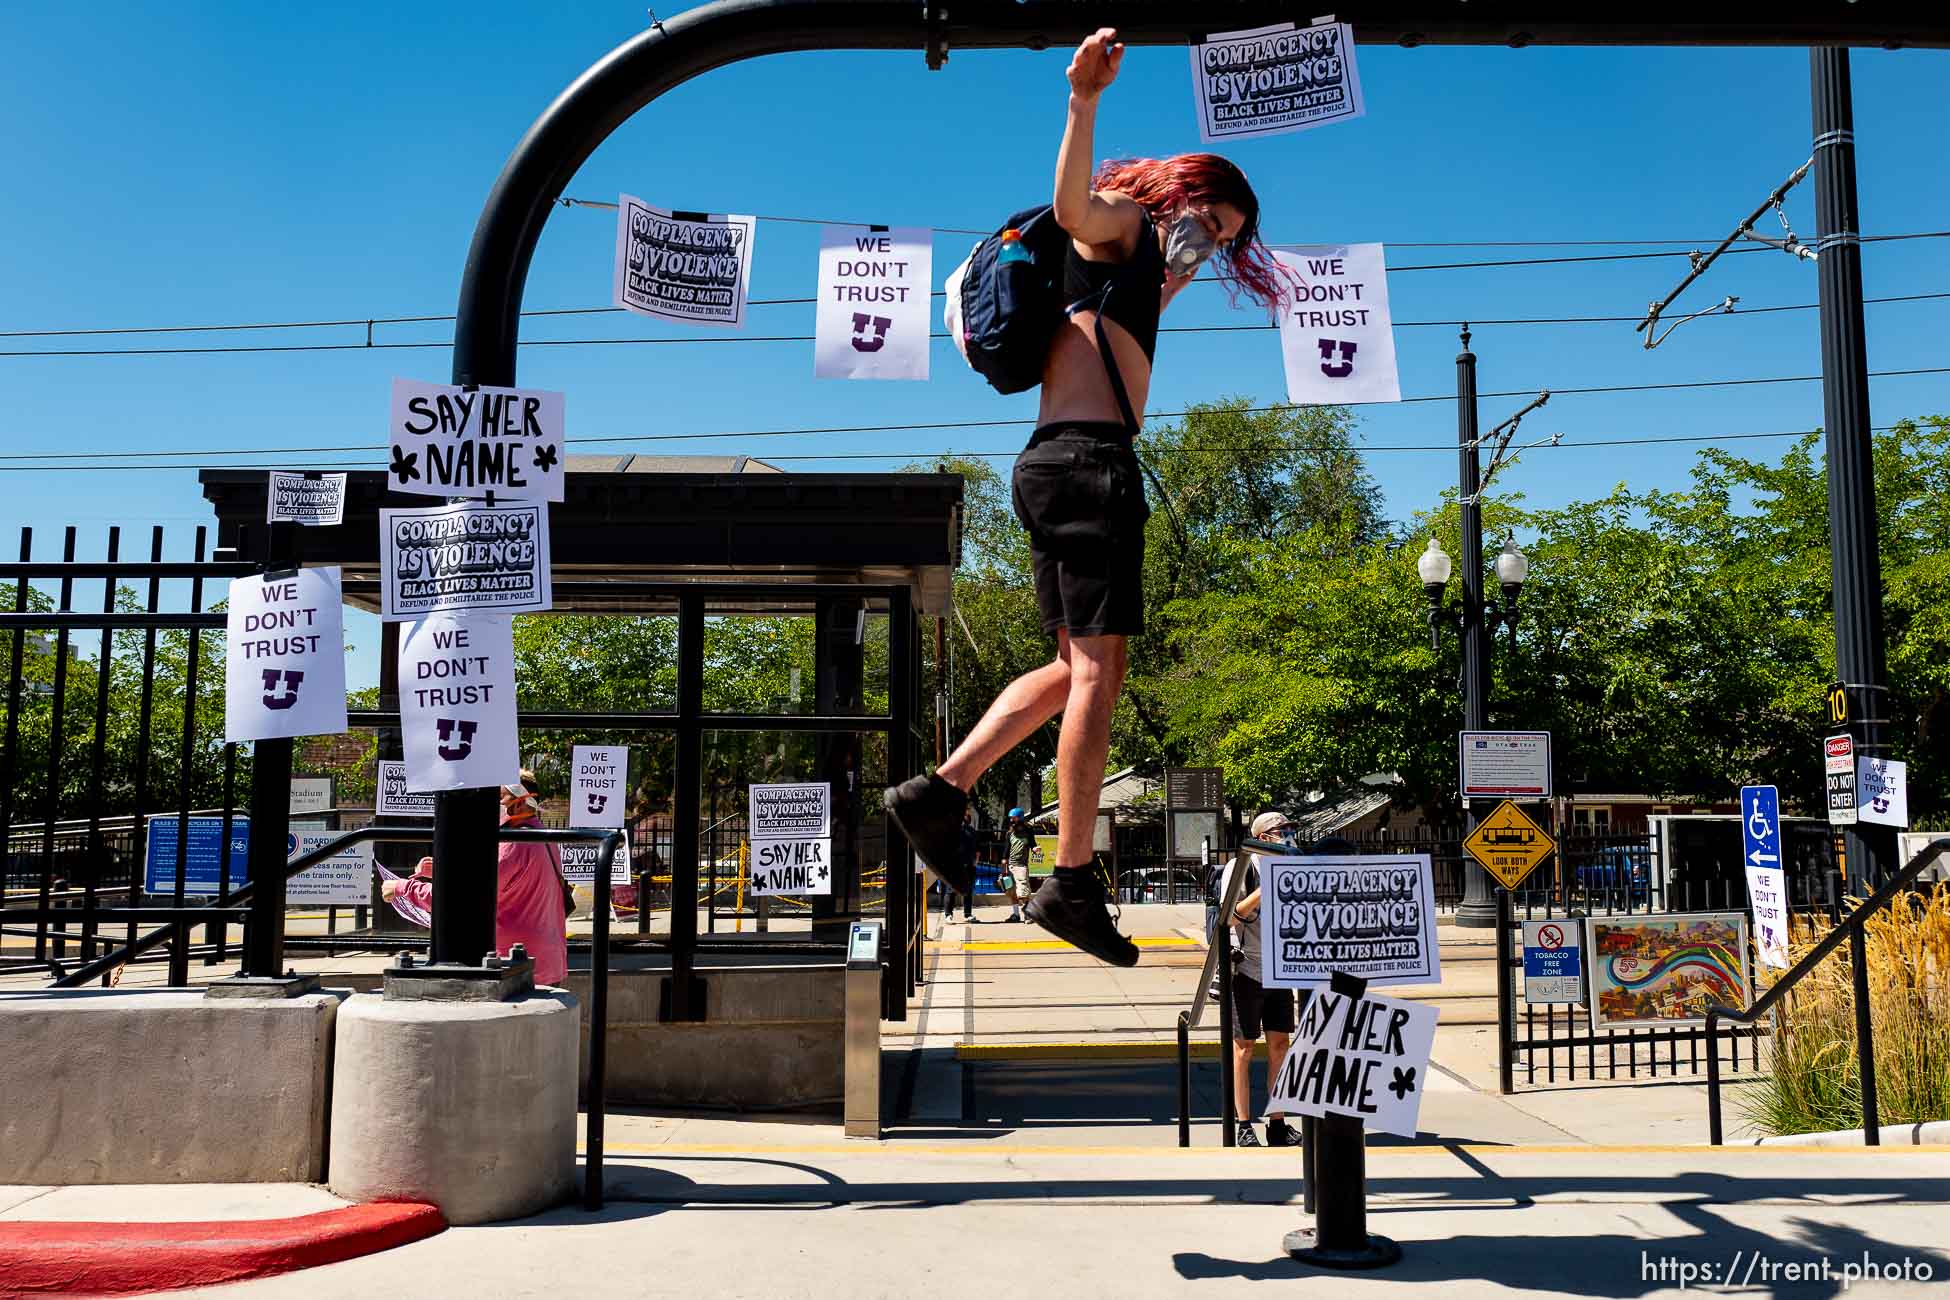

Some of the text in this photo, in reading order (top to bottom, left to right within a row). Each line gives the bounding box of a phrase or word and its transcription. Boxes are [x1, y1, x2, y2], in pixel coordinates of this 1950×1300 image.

[1205, 28, 1338, 74] COMPLACENCY
[1209, 55, 1342, 103] IS VIOLENCE
[1216, 88, 1342, 120] BLACK LIVES MATTER
[1215, 102, 1346, 130] DEFUND AND DEMILITARIZE THE POLICE
[632, 211, 742, 255] COMPLACENCY
[855, 237, 891, 253] WE
[630, 239, 739, 286] IS VIOLENCE
[837, 261, 909, 278] DON'T
[1308, 258, 1345, 276] WE
[630, 274, 731, 304] BLACK LIVES MATTER
[833, 285, 910, 303] TRUST
[1295, 284, 1364, 302] DON'T
[646, 298, 659, 306] AND
[660, 301, 705, 314] DEMILITARIZE
[1294, 309, 1370, 328] TRUST
[404, 393, 543, 439] SAY HER
[426, 439, 527, 488] NAME
[277, 479, 340, 492] COMPLACENCY
[276, 491, 339, 506] IS VIOLENCE
[315, 507, 336, 515] MATTER
[396, 513, 535, 548] COMPLACENCY
[398, 541, 535, 579] IS VIOLENCE
[261, 583, 298, 603] WE
[403, 575, 531, 596] BLACK LIVES MATTER
[400, 590, 535, 608] DEFUND AND DEMILITARIZE THE POLICE
[245, 608, 317, 633] DON'T
[241, 635, 321, 659] TRUST
[432, 630, 470, 649] WE
[417, 656, 489, 679] DON'T
[414, 684, 493, 708] TRUST
[1828, 688, 1846, 721] 10
[1827, 741, 1850, 753] DANGER
[590, 752, 608, 761] WE
[581, 765, 616, 775] DON'T
[1871, 763, 1888, 773] WE
[385, 780, 398, 795] IS
[579, 779, 617, 788] TRUST
[1828, 774, 1854, 790] DO NOT
[1864, 773, 1896, 785] DON'T
[756, 789, 823, 803] COMPLACENCY
[1863, 783, 1897, 795] TRUST
[757, 801, 823, 818] IS VIOLENCE
[1831, 793, 1853, 808] ENTER
[562, 848, 625, 863] IS VIOCE
[759, 842, 822, 866] SAY HER
[1492, 855, 1528, 866] LOOK BOTH
[332, 862, 352, 871] ramp
[354, 861, 365, 869] for
[1501, 865, 1520, 875] WAYS
[769, 866, 815, 890] NAME
[1278, 869, 1417, 901] COMPLACENCY
[1757, 875, 1770, 887] WE
[1280, 901, 1419, 938] IS VIOLENCE
[1755, 905, 1779, 920] TRUST
[1285, 941, 1418, 960] BLACK LIVES MATTER
[1282, 964, 1316, 973] DEFUND
[1317, 963, 1335, 973] AND
[1383, 962, 1395, 970] THE
[1396, 960, 1422, 969] POLICE
[1542, 968, 1563, 976] ZONE
[1291, 994, 1410, 1056] AY HER
[1272, 1048, 1382, 1113] NAME
